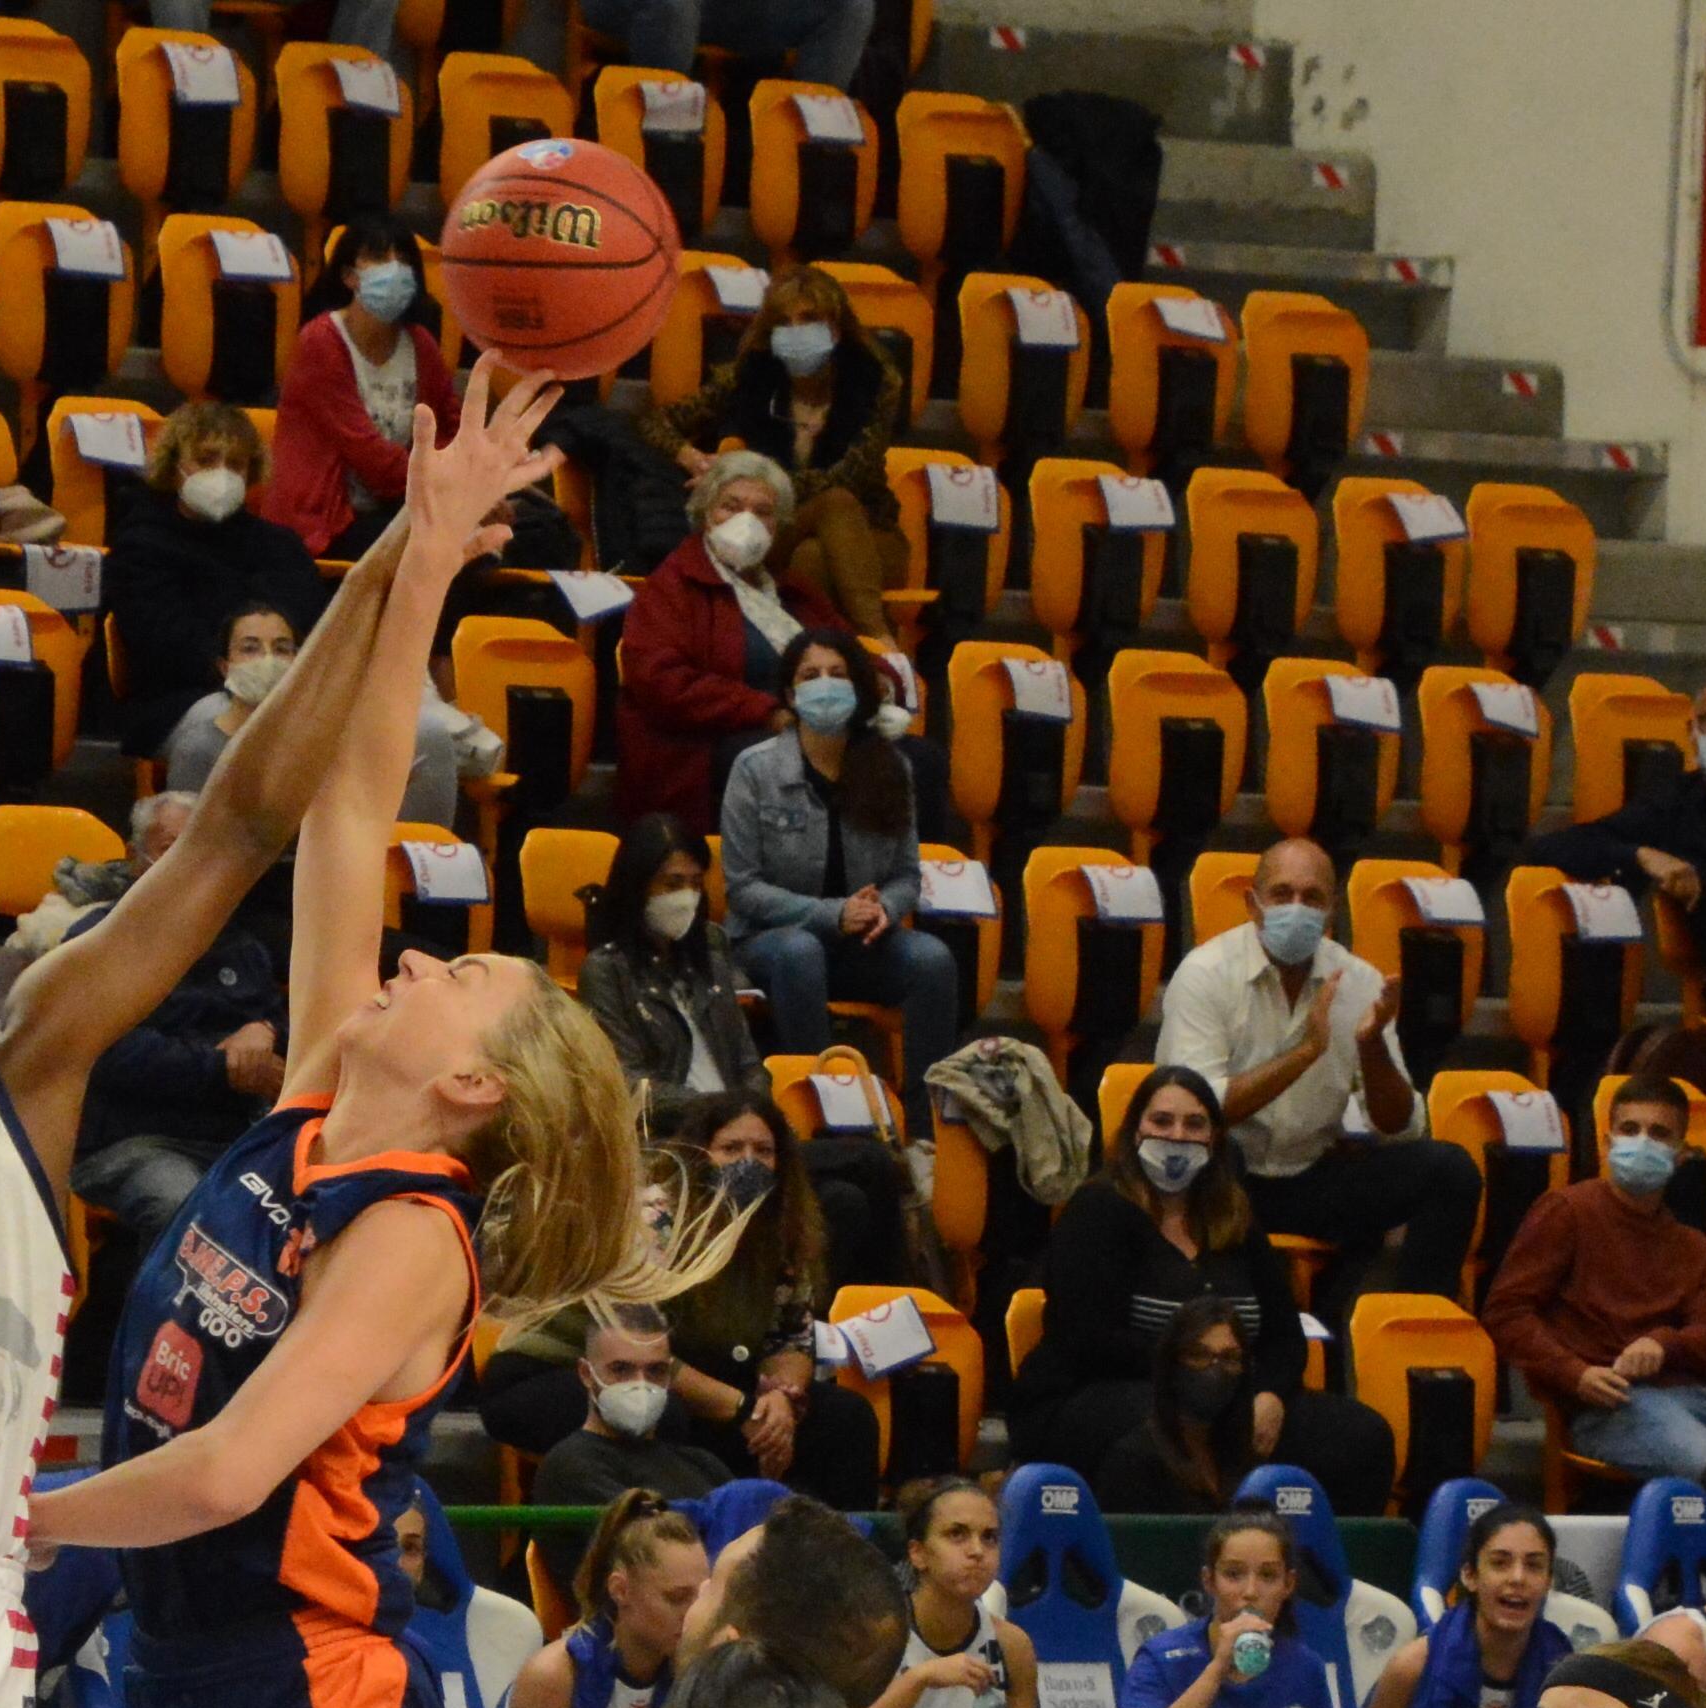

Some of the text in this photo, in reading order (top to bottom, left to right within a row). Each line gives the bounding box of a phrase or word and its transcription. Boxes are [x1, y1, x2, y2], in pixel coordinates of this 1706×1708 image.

[155, 1340, 191, 1381] Bric
[1041, 1490, 1080, 1511] OMP
[1275, 1490, 1313, 1511] OMP
